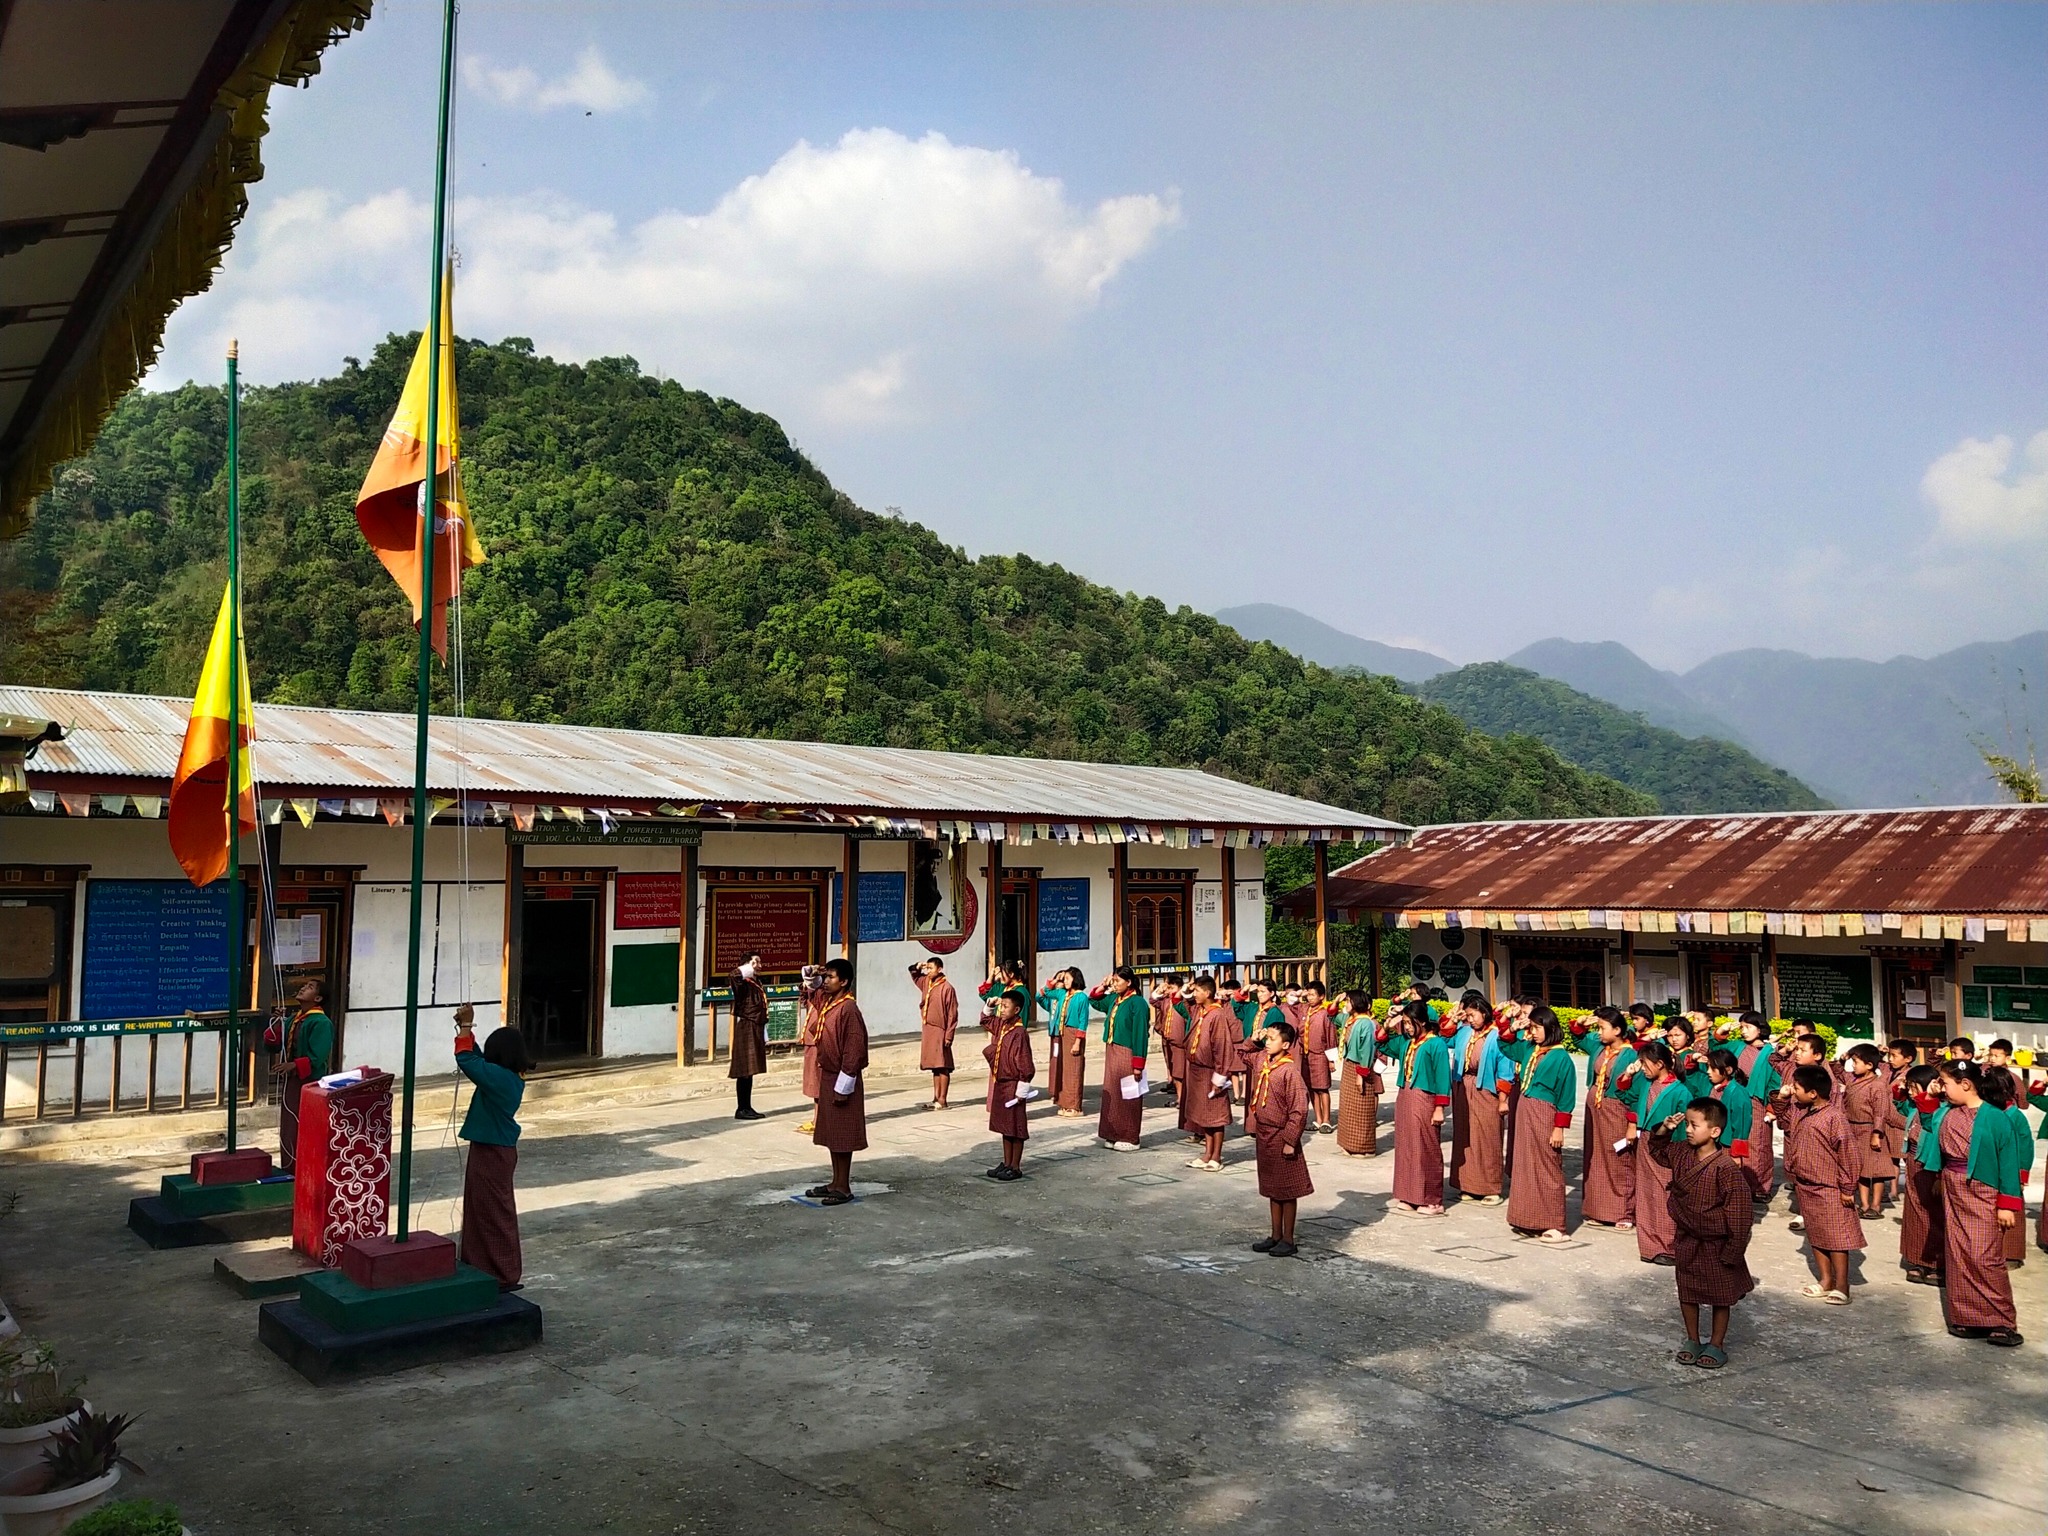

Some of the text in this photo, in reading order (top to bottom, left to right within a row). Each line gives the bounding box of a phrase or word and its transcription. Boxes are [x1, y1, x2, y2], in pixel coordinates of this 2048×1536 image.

[576, 825, 591, 833] THE
[626, 826, 664, 834] POWERFUL
[670, 827, 699, 835] WEAPON
[511, 834, 539, 842] WHICH
[371, 886, 396, 894] Literary
[161, 897, 211, 905] Self-awareness
[192, 907, 223, 915] Thinking
[195, 920, 227, 928] Thinking
[159, 944, 190, 952] Empathy
[193, 955, 219, 963] Solving
[158, 976, 205, 984] Interpersonal
[712, 989, 729, 997] book
[775, 985, 792, 994] ignite
[157, 994, 182, 1002] Coping
[60, 1025, 85, 1033] BOOK
[89, 1024, 98, 1032] IS
[102, 1023, 120, 1031] LIKE
[125, 1020, 172, 1030] RE-WRITING
[177, 1020, 185, 1028] IT
[188, 1019, 205, 1027] FOR
